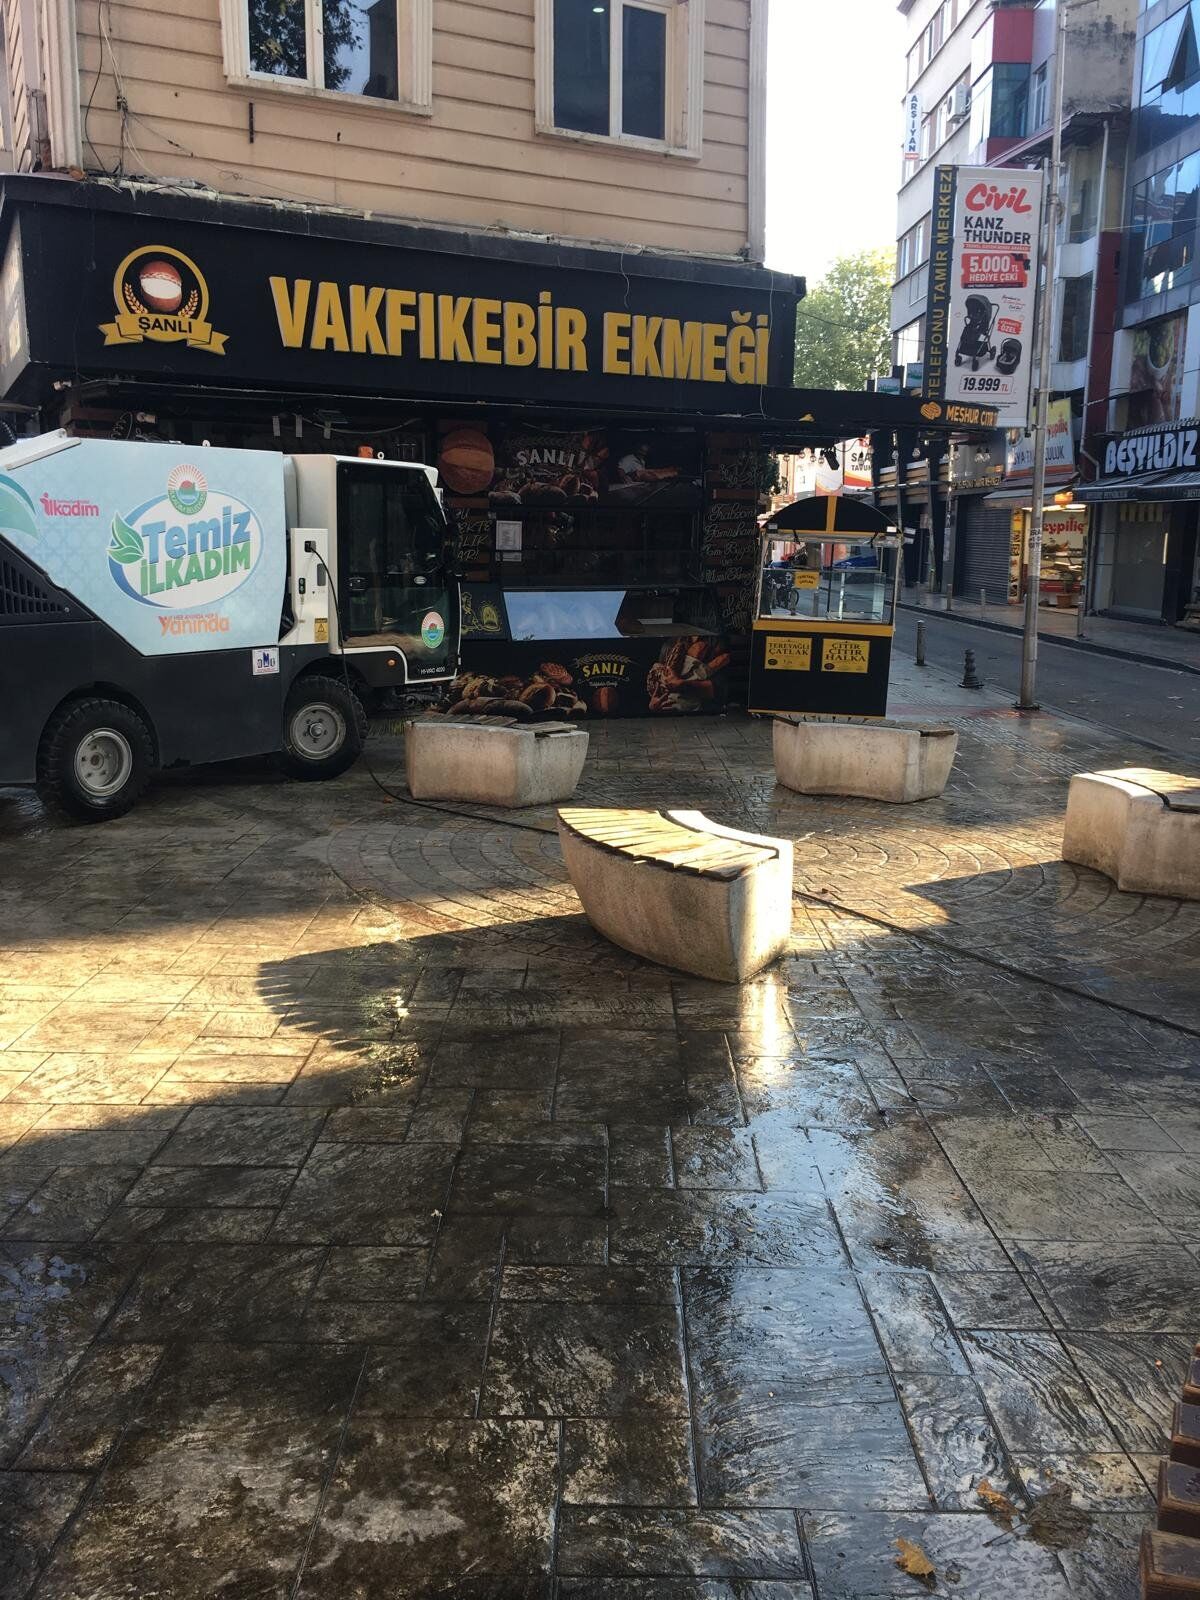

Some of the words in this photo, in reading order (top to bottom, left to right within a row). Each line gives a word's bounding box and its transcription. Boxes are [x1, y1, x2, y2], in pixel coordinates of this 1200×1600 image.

[964, 216, 1004, 230] KANZ
[963, 230, 1031, 245] THUNDER
[970, 256, 1010, 273] 5.000
[969, 273, 998, 282] HEDİYE
[138, 316, 193, 333] ŞANLI
[269, 276, 588, 372] VAKFIKEBİR
[602, 310, 769, 385] EKMEĞİ
[927, 308, 945, 398] TELEFONU
[963, 377, 1000, 391] 19.999
[1001, 383, 1009, 392] TL
[1105, 430, 1198, 476] BEŞYILDIZ
[141, 506, 251, 565] Temiz
[139, 541, 251, 597] İLKADIM
[825, 654, 866, 662] HALKA
